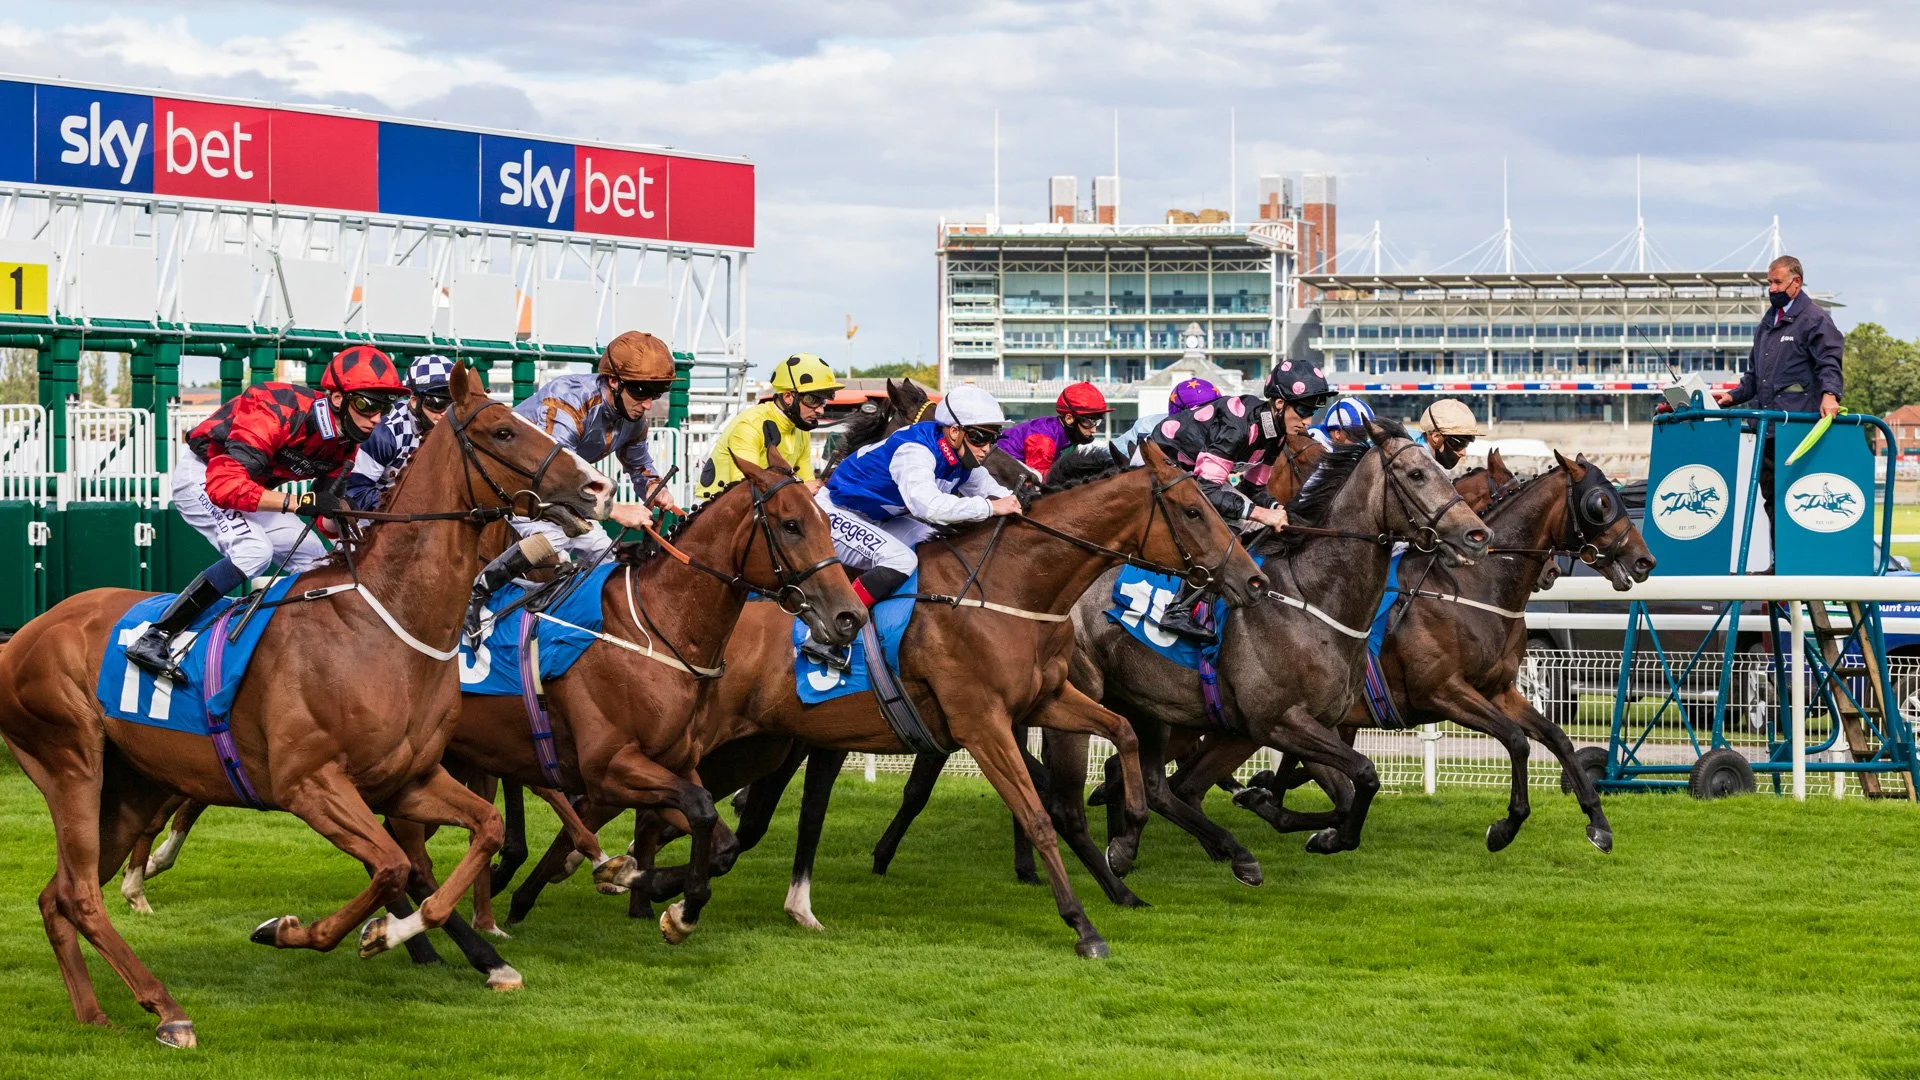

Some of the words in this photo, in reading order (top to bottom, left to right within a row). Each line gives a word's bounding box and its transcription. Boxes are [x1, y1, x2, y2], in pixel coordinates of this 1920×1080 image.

[60, 102, 148, 185] sky
[167, 111, 253, 180] bet
[500, 149, 571, 223] sky
[585, 157, 655, 219] bet
[10, 266, 23, 310] 1
[117, 620, 199, 720] 11
